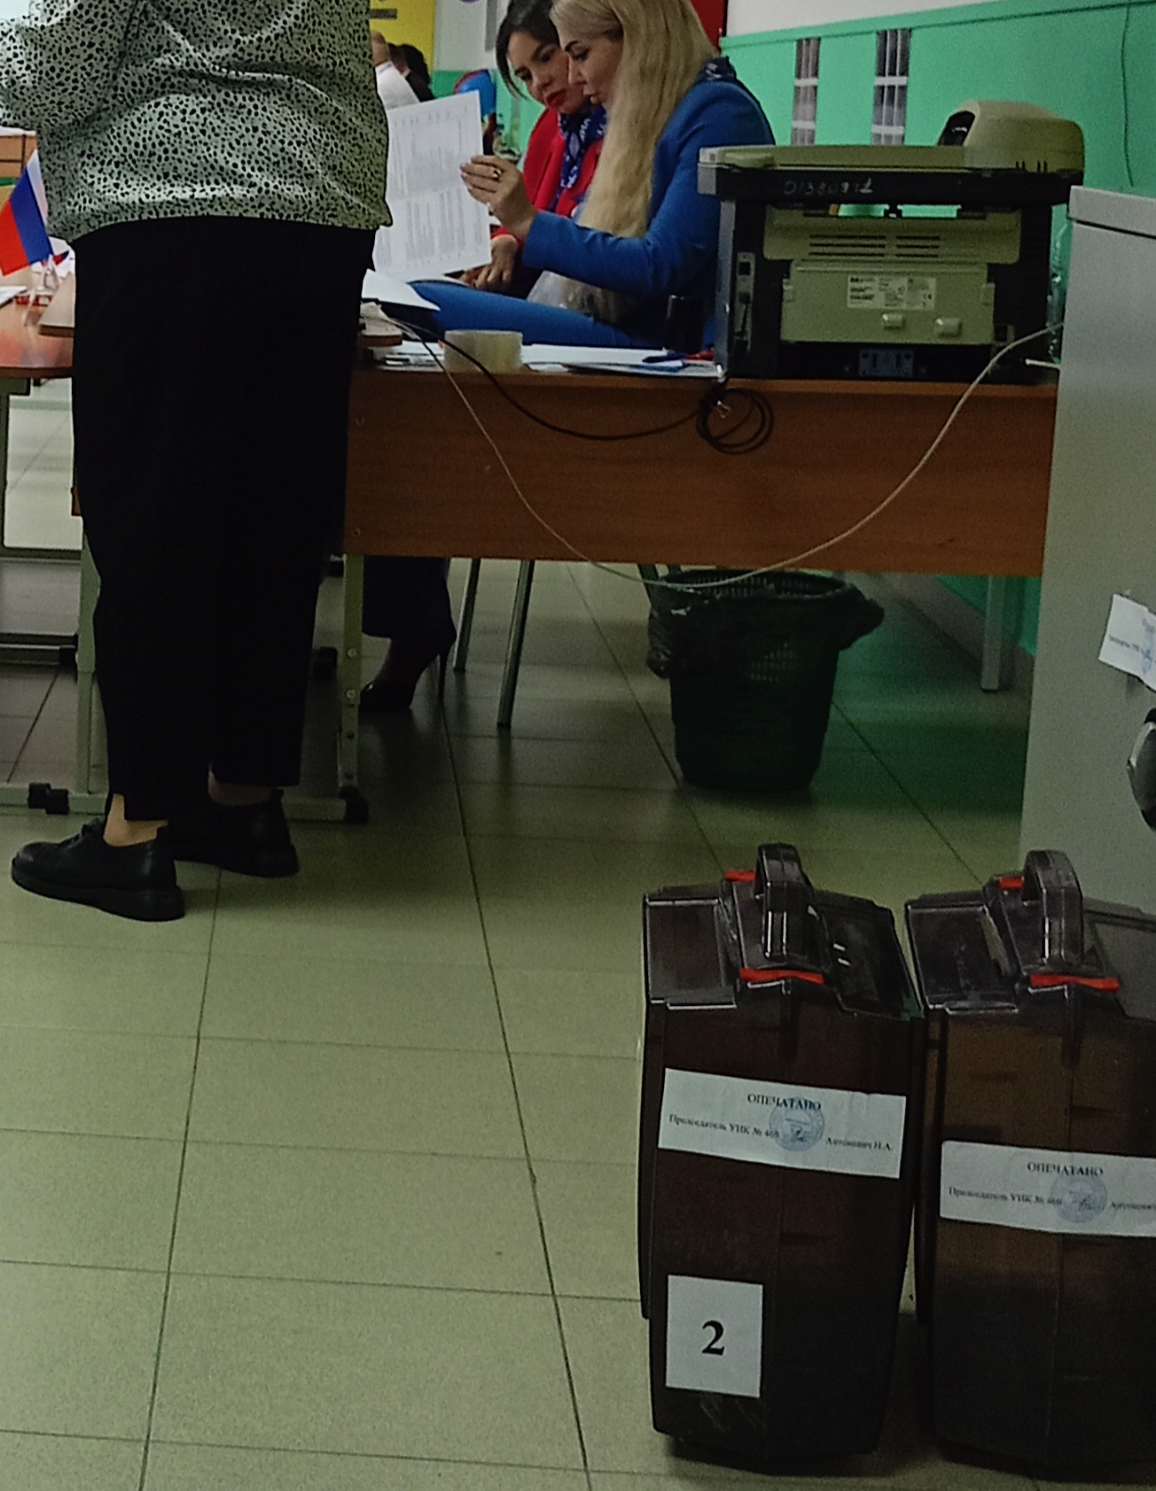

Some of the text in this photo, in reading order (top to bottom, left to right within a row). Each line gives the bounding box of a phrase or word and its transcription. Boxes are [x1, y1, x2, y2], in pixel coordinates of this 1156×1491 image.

[747, 1092, 822, 1111] ОПЕЧАТАНО
[1027, 1161, 1104, 1177] ОПЕЧАТАНО
[701, 1319, 726, 1357] 2
